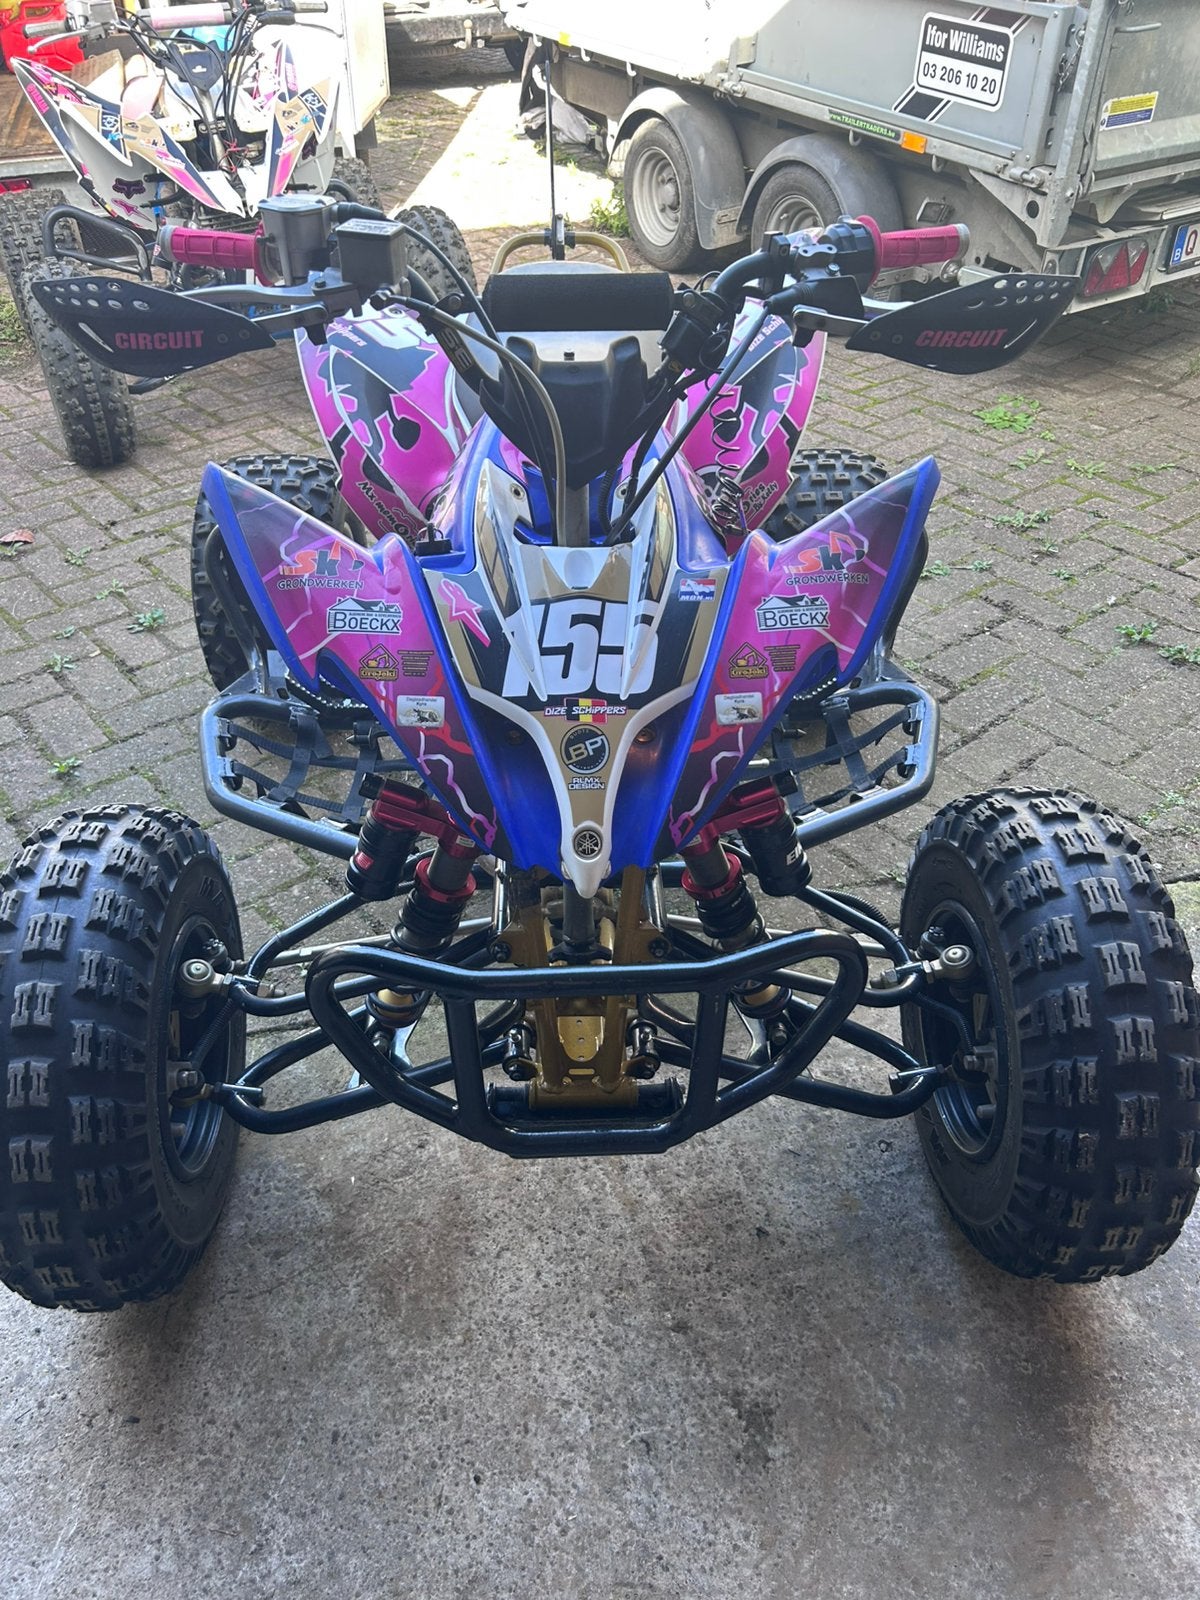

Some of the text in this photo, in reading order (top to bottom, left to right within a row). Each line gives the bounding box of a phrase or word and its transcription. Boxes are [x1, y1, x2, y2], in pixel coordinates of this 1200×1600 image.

[926, 24, 1005, 62] Ifor Williams
[923, 62, 997, 94] 03 206 10 20
[115, 330, 204, 350] CIRCUIT
[915, 328, 1008, 348] CIRCUIT
[277, 577, 365, 591] GRONDWERKEN
[785, 572, 869, 587] GRONDWERKEN
[333, 611, 401, 631] BOECKX
[763, 610, 829, 628] BOECKX
[545, 706, 568, 716] DIZE
